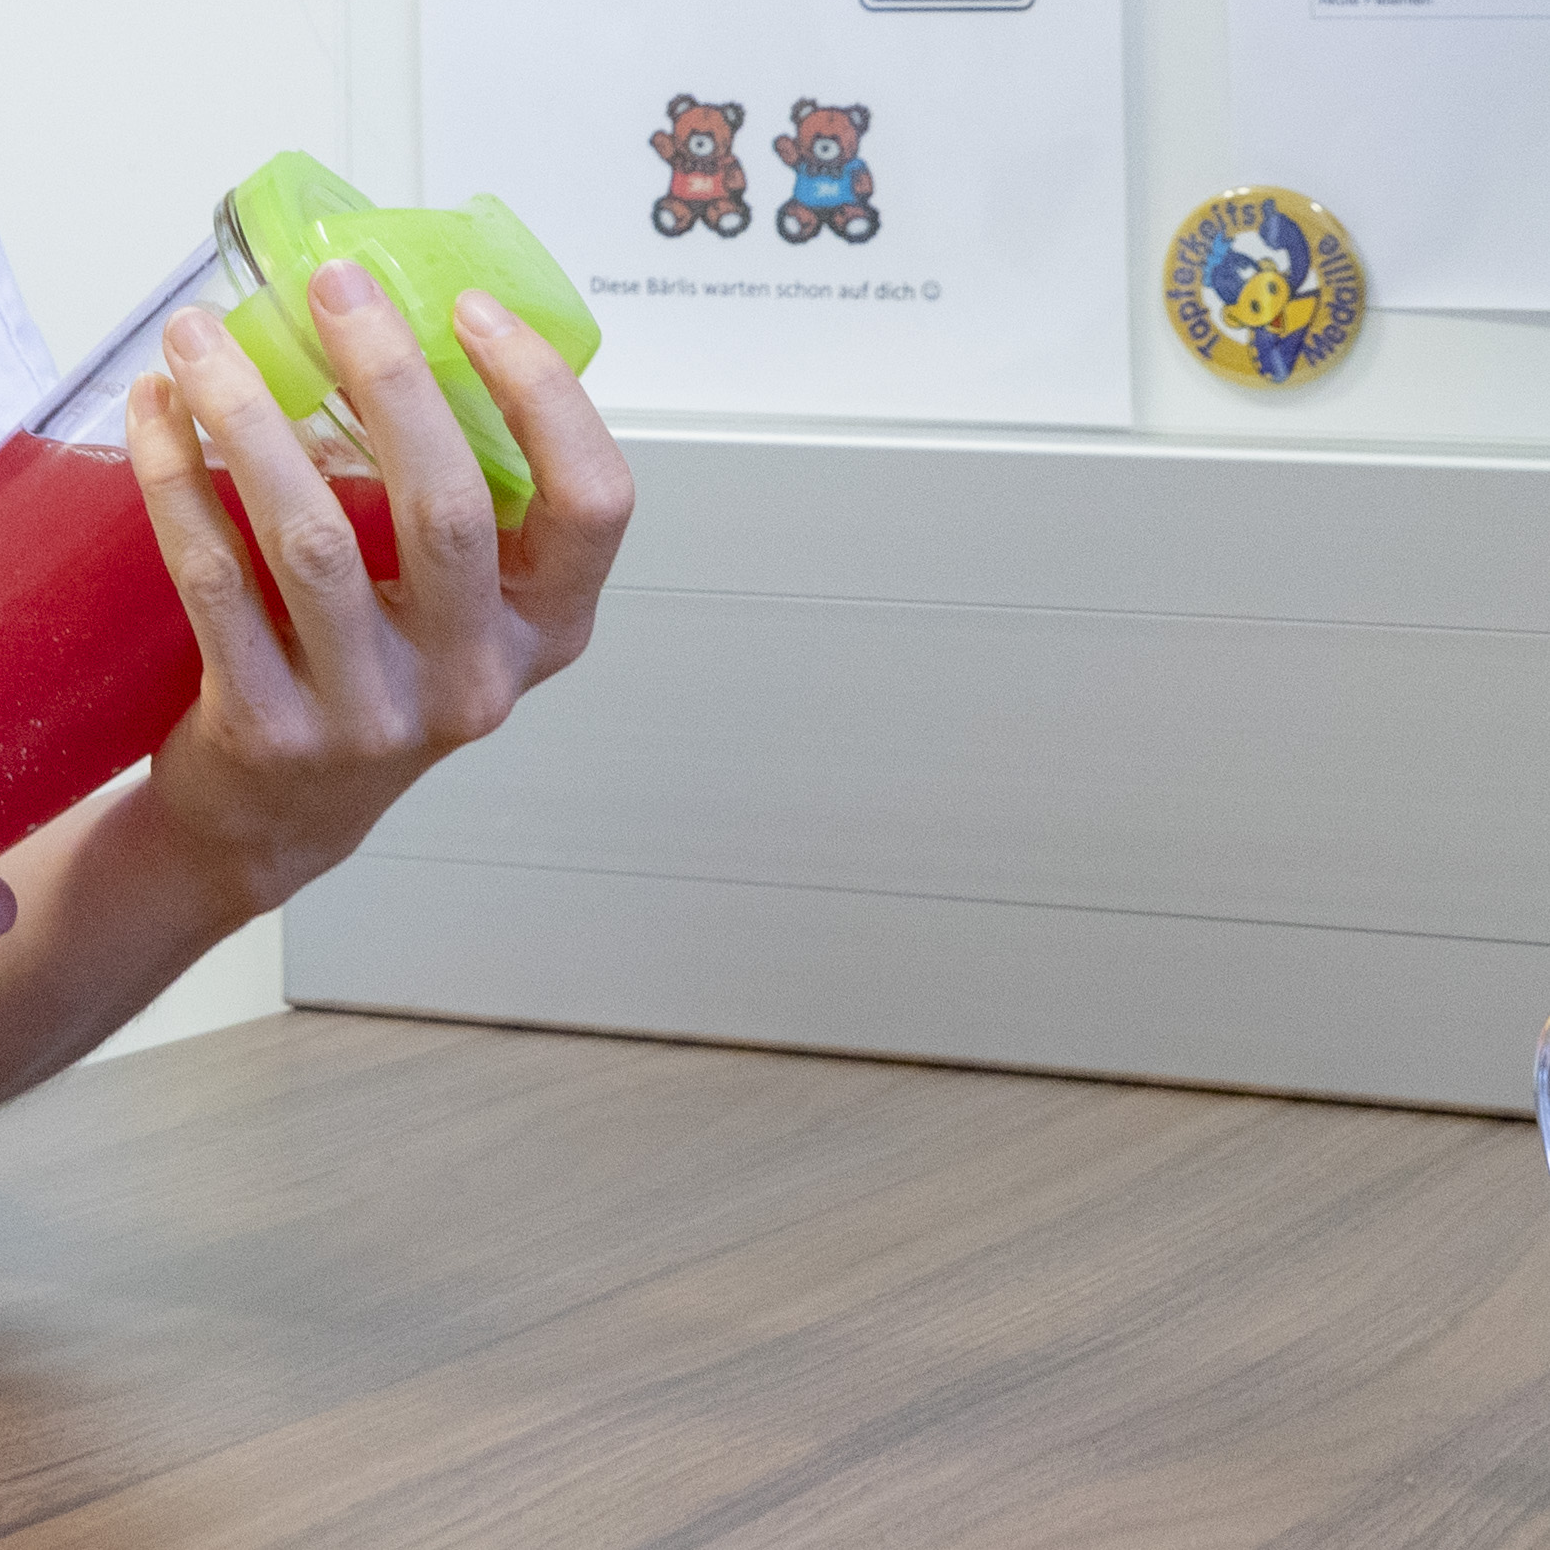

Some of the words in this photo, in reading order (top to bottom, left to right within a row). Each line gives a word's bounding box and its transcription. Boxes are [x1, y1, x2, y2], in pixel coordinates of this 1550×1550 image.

[590, 275, 640, 296] Diese
[702, 279, 771, 298] warten
[775, 278, 833, 299] schon
[838, 279, 869, 300] auf
[874, 281, 916, 301] dich
[1166, 200, 1256, 361] Tapferkeits
[1302, 233, 1359, 368] Medaille
